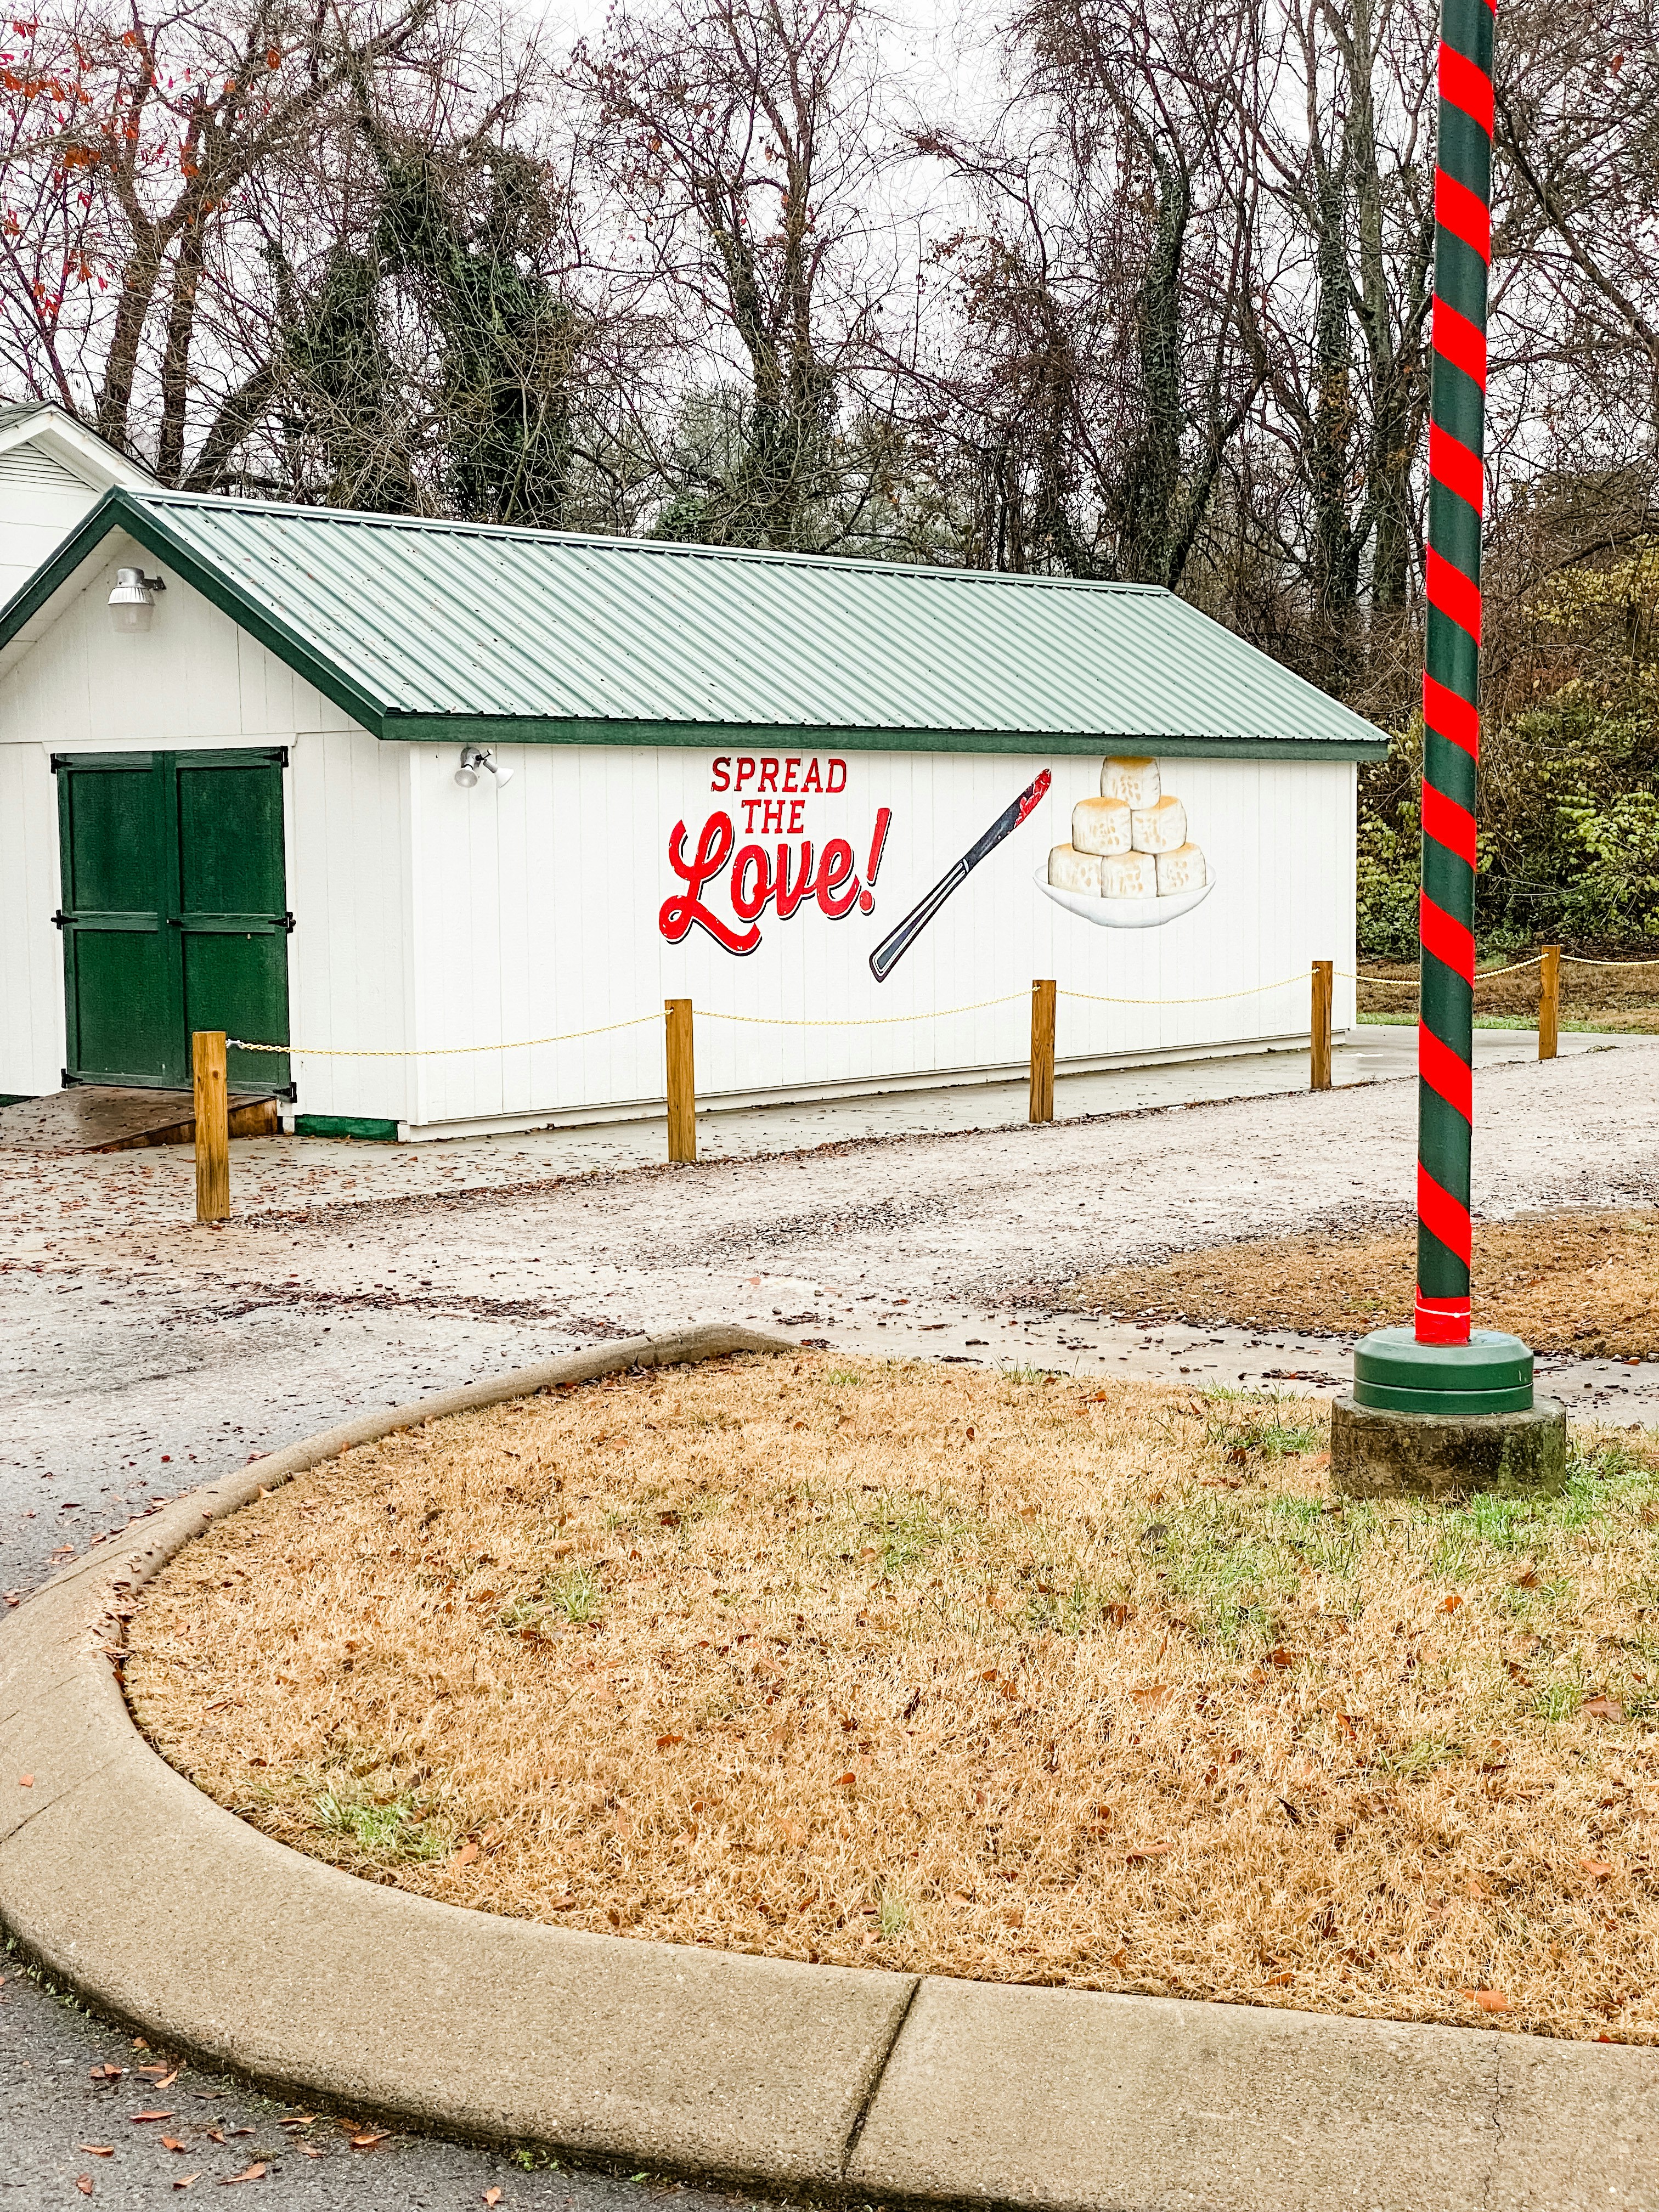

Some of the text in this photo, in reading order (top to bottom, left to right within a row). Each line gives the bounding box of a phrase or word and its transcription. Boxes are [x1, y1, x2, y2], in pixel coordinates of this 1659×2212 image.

[711, 757, 847, 793] SPREAD
[741, 799, 805, 834] THE
[659, 808, 893, 957] Love!
